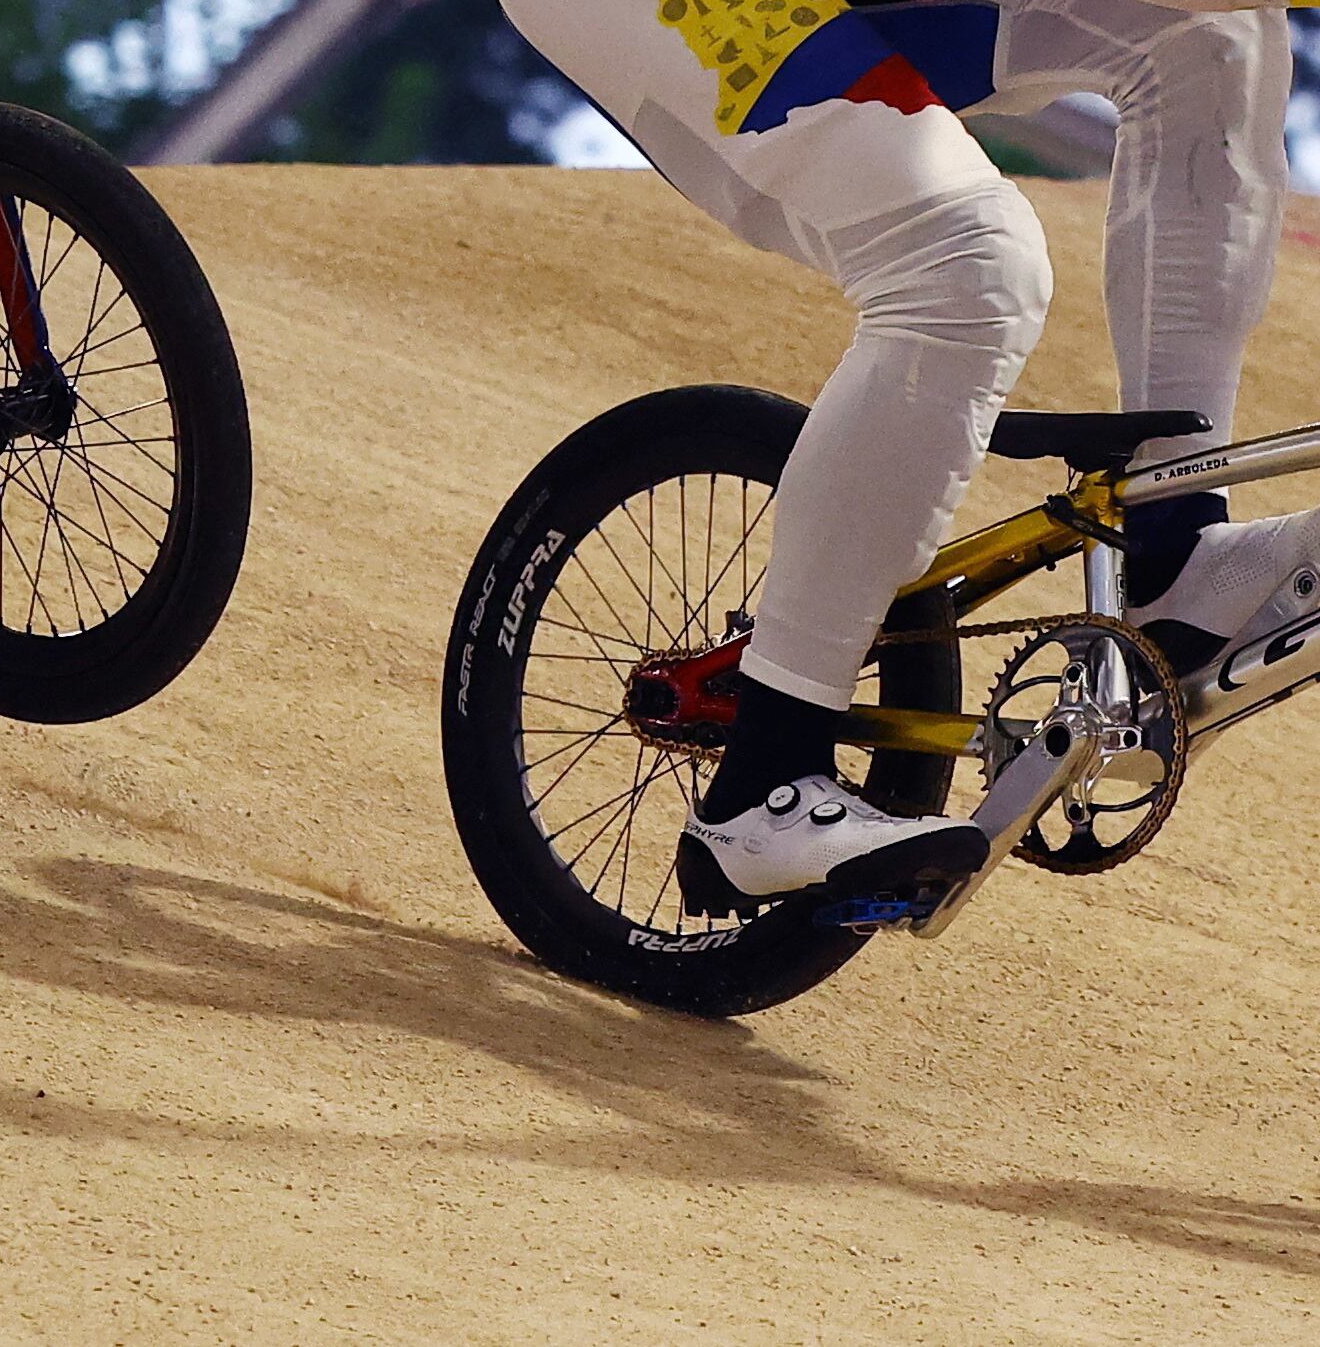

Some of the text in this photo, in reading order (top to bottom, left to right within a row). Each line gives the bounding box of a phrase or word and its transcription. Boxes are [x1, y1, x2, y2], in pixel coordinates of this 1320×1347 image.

[1168, 456, 1230, 479] ARBOLEDA
[497, 528, 567, 658] ZUPPRA
[627, 925, 744, 953] ZUPPRA
